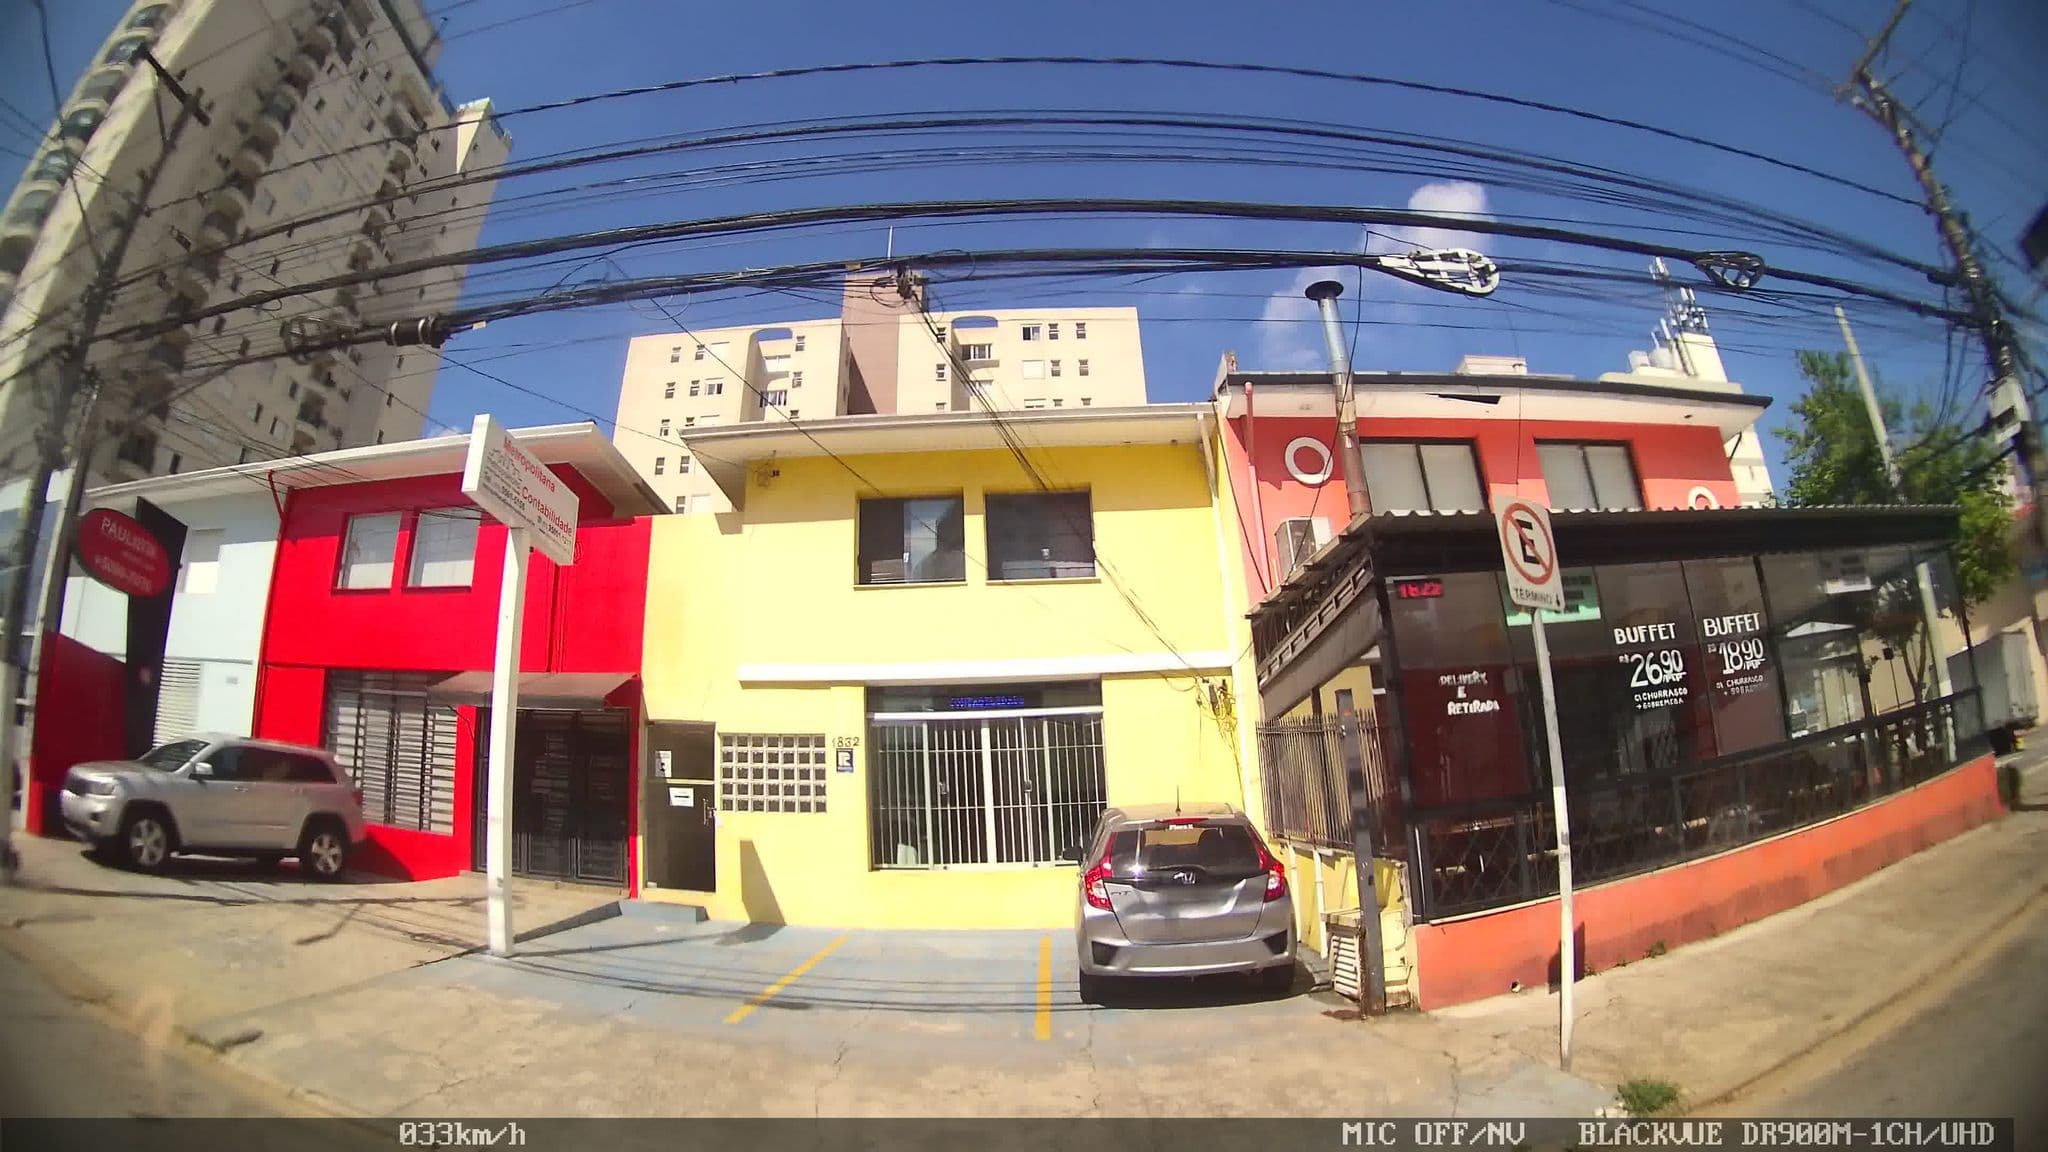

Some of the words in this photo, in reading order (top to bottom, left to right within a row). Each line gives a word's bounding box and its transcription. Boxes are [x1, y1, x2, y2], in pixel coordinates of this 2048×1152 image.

[503, 437, 556, 493] Metropolitana
[521, 486, 573, 537] Contabilidade
[1613, 622, 1676, 645] BUFFET
[1703, 612, 1761, 637] BUFFET
[1439, 670, 1488, 686] DELIVERY
[1457, 686, 1467, 699] E
[1447, 700, 1500, 716] RETIRADA
